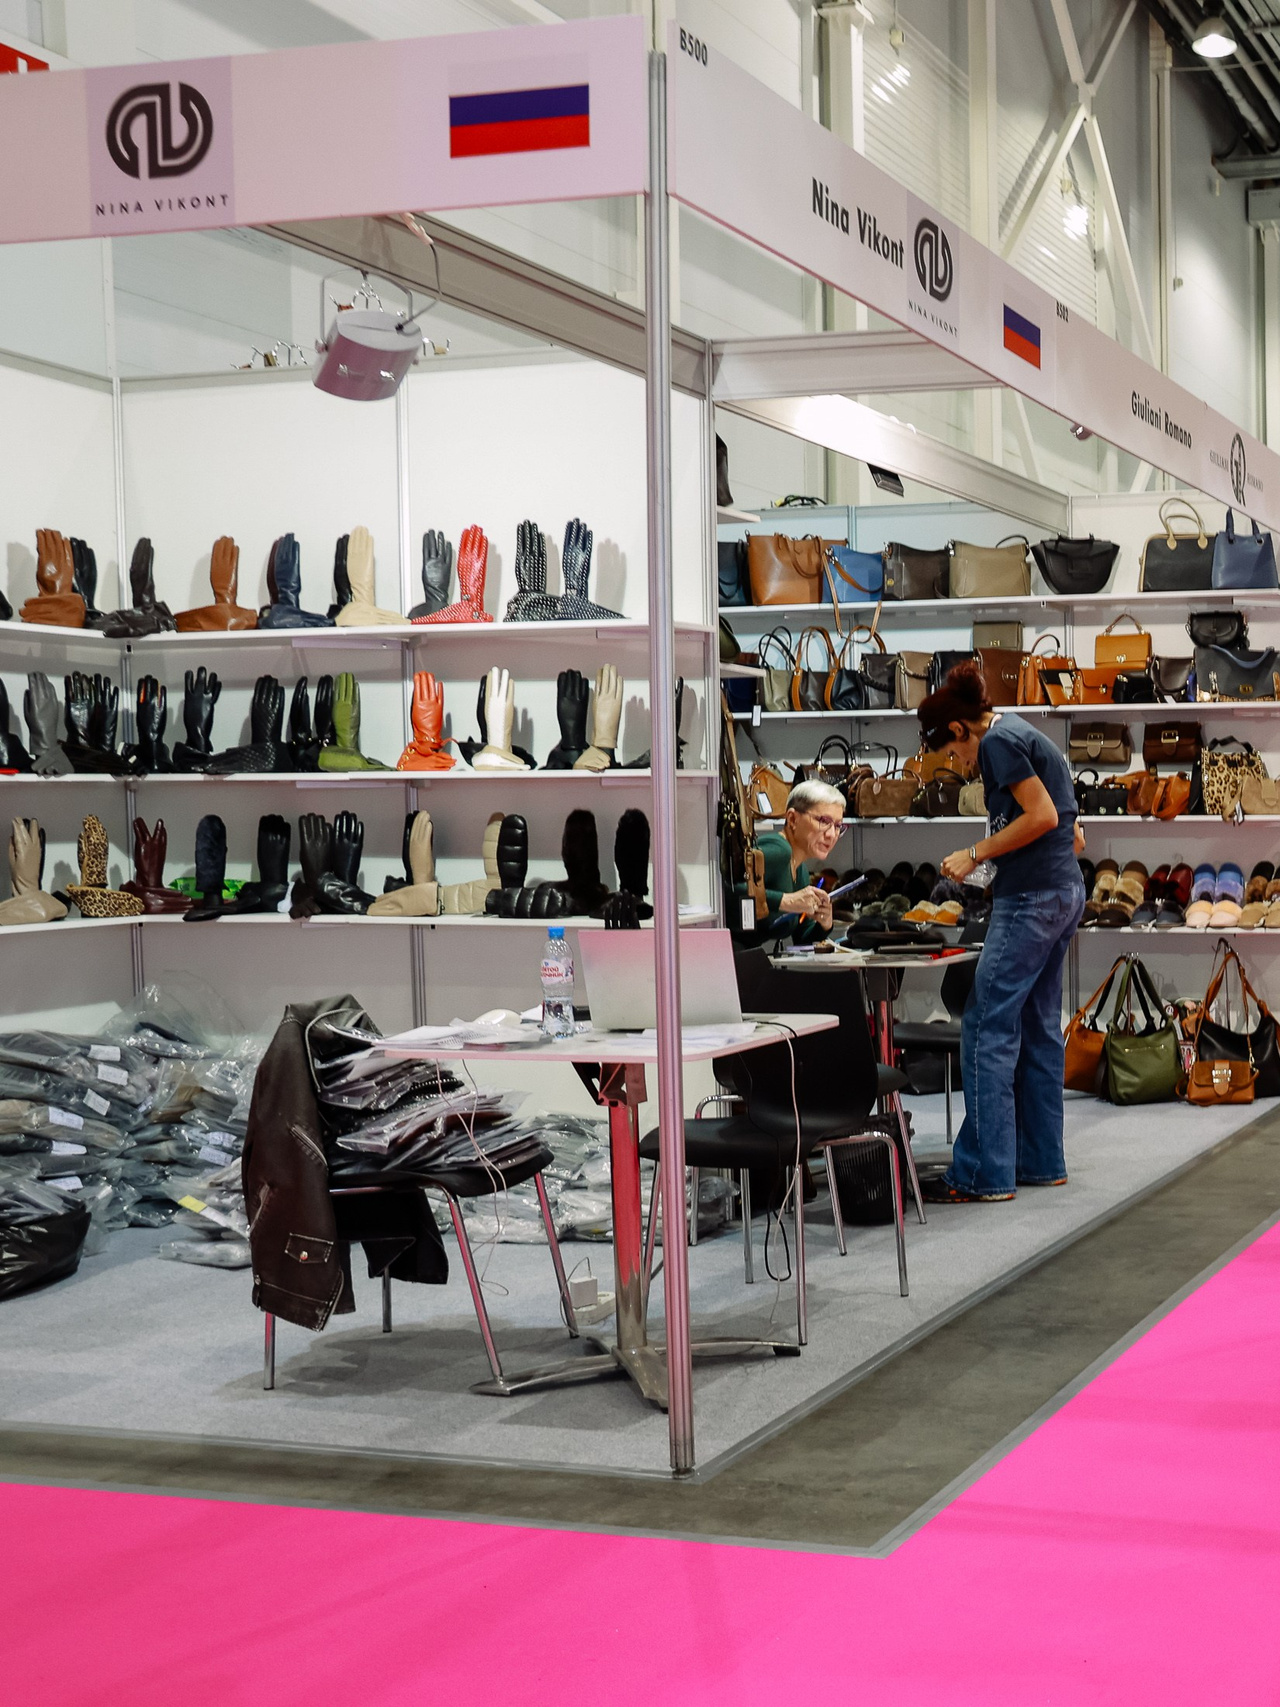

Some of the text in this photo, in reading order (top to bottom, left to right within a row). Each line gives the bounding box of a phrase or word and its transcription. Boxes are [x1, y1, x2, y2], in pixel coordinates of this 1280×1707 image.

[680, 26, 708, 67] B500
[95, 194, 229, 216] NINA VIKONT
[812, 175, 905, 270] Nina Vikont
[908, 299, 958, 338] NINA VIKONT
[1131, 390, 1192, 450] Giuliani Romano
